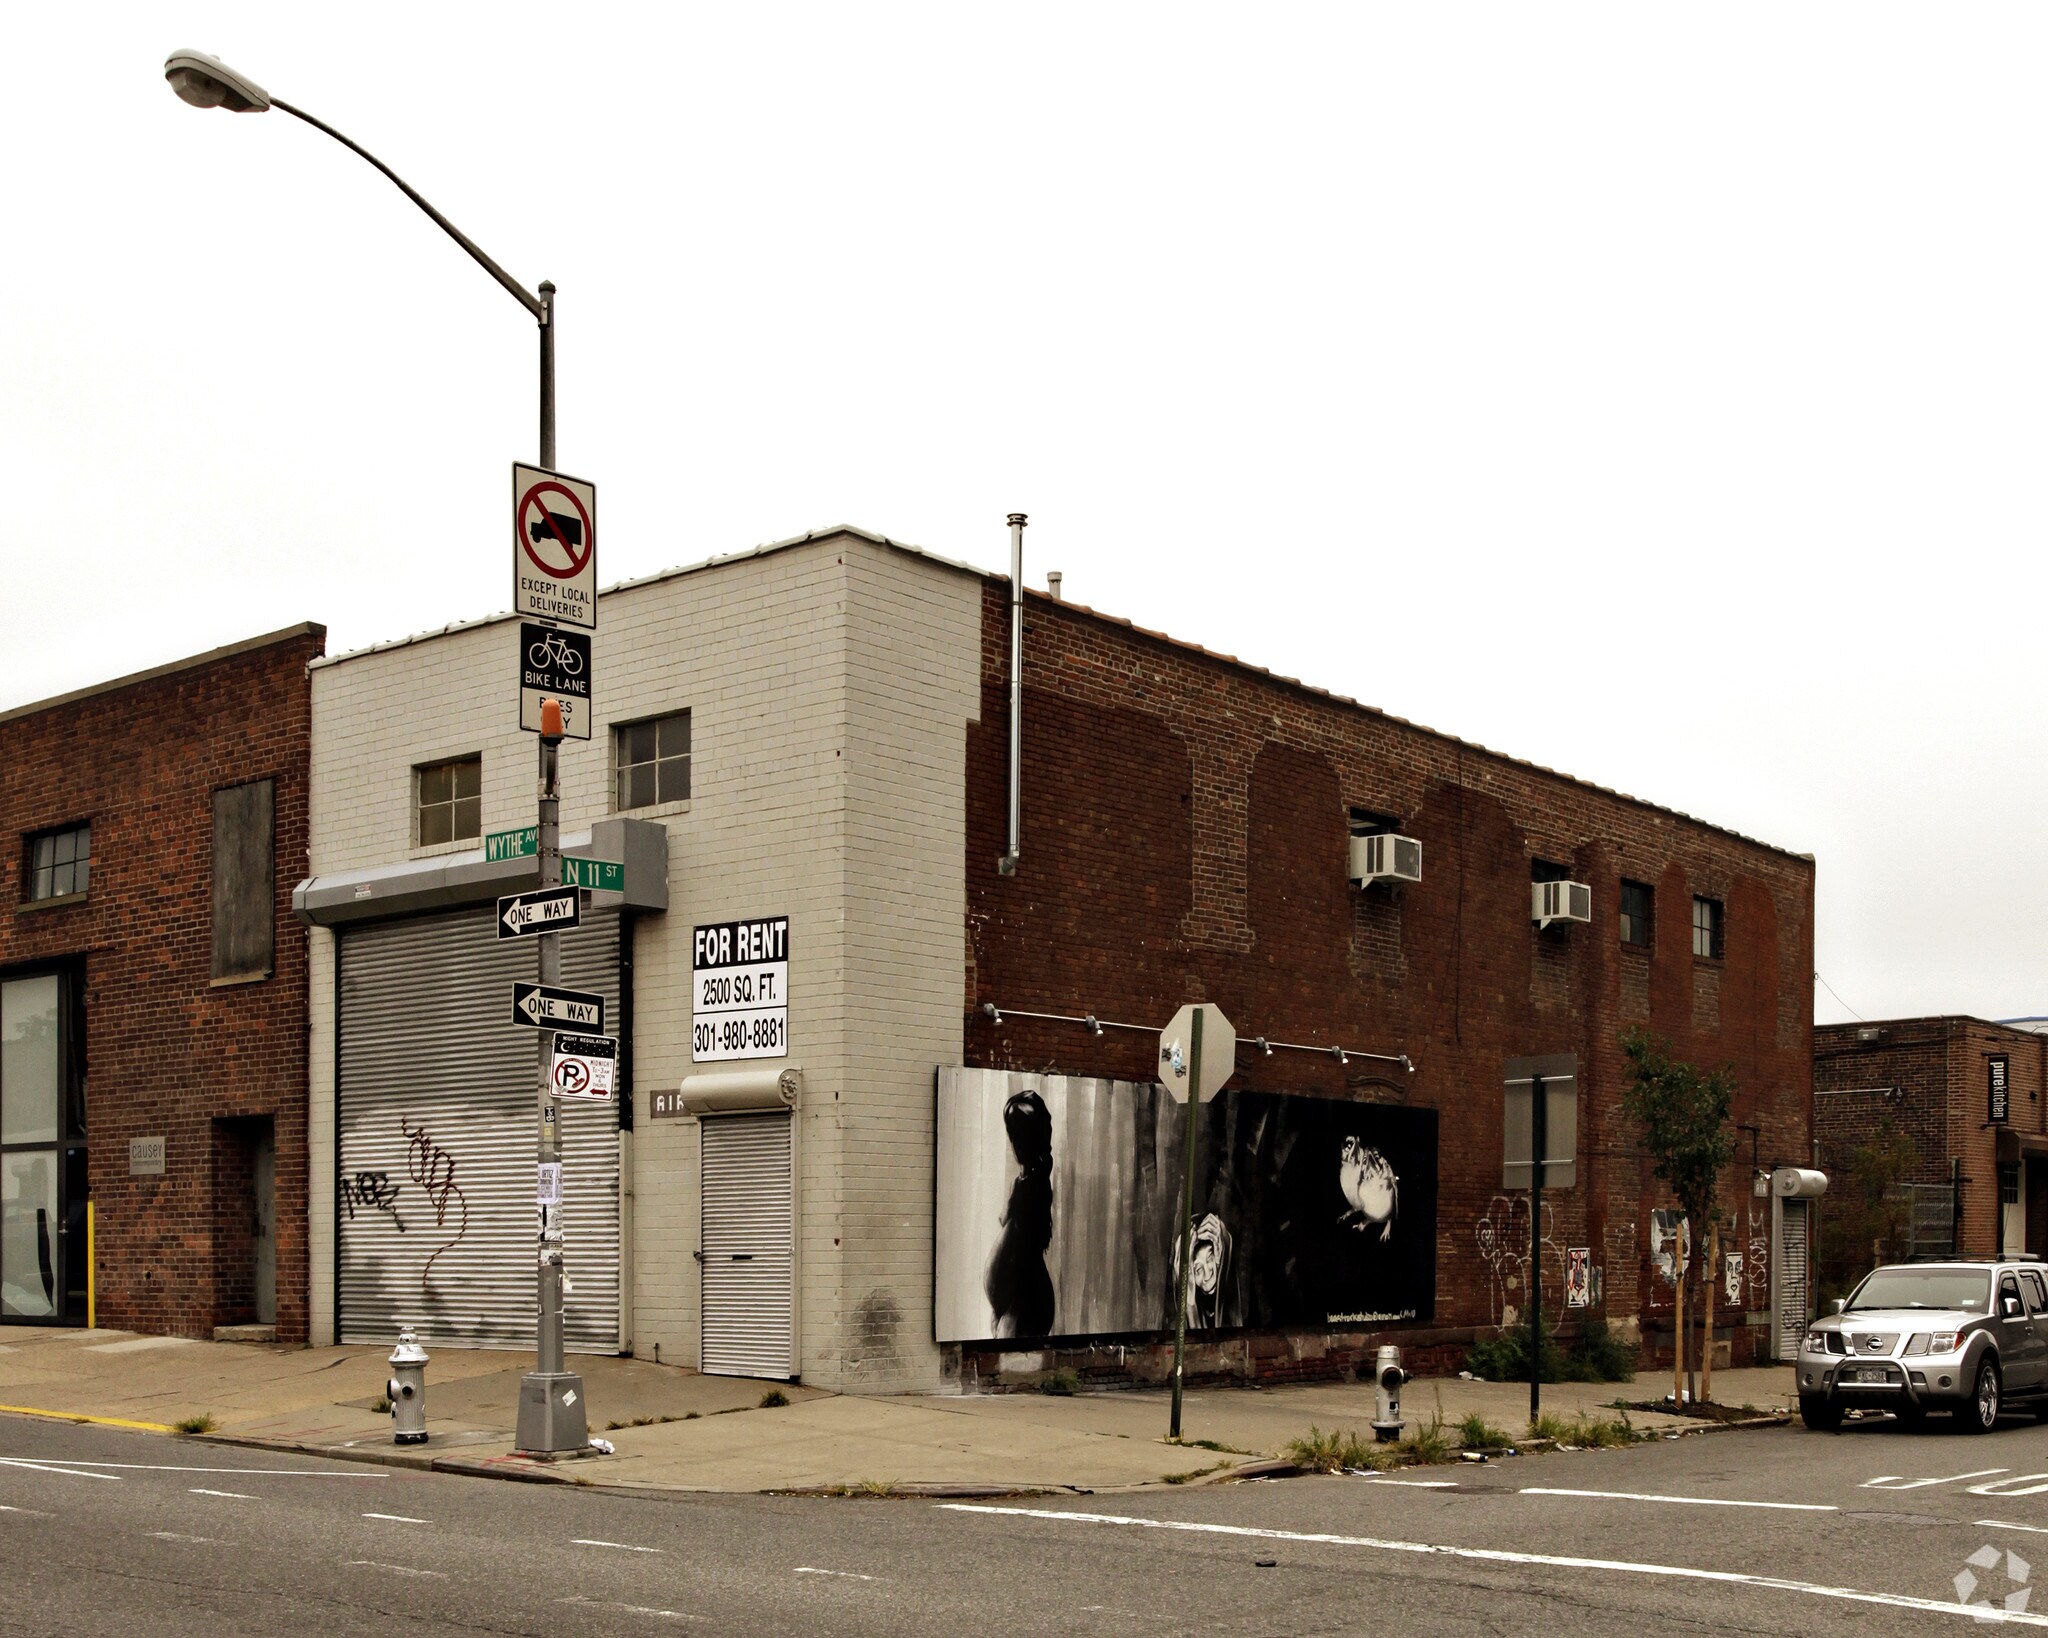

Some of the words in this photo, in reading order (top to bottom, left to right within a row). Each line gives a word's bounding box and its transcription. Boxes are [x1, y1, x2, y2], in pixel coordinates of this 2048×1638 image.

[521, 577, 557, 596] EXCEPT
[562, 587, 590, 604] LOCAL
[530, 595, 583, 618] DELIVERIES
[525, 670, 551, 687] BIKE
[555, 676, 587, 693] LANE
[488, 832, 524, 860] WYTHE
[525, 830, 536, 843] AV
[566, 860, 579, 884] N
[587, 863, 600, 887] 11
[606, 865, 617, 877] ST
[510, 906, 532, 924] ONE
[543, 900, 569, 919] WAY
[695, 928, 731, 966] FOR
[737, 921, 787, 961] RENT
[703, 977, 731, 1006] 2500
[734, 974, 755, 1003] SQ.
[759, 972, 776, 1000] FT.
[528, 997, 555, 1016] ONE
[567, 1003, 593, 1021] WAY
[580, 1037, 610, 1045] REGULATION
[694, 1017, 783, 1053] 301-980-8881
[1990, 1062, 2007, 1118] purekitchen
